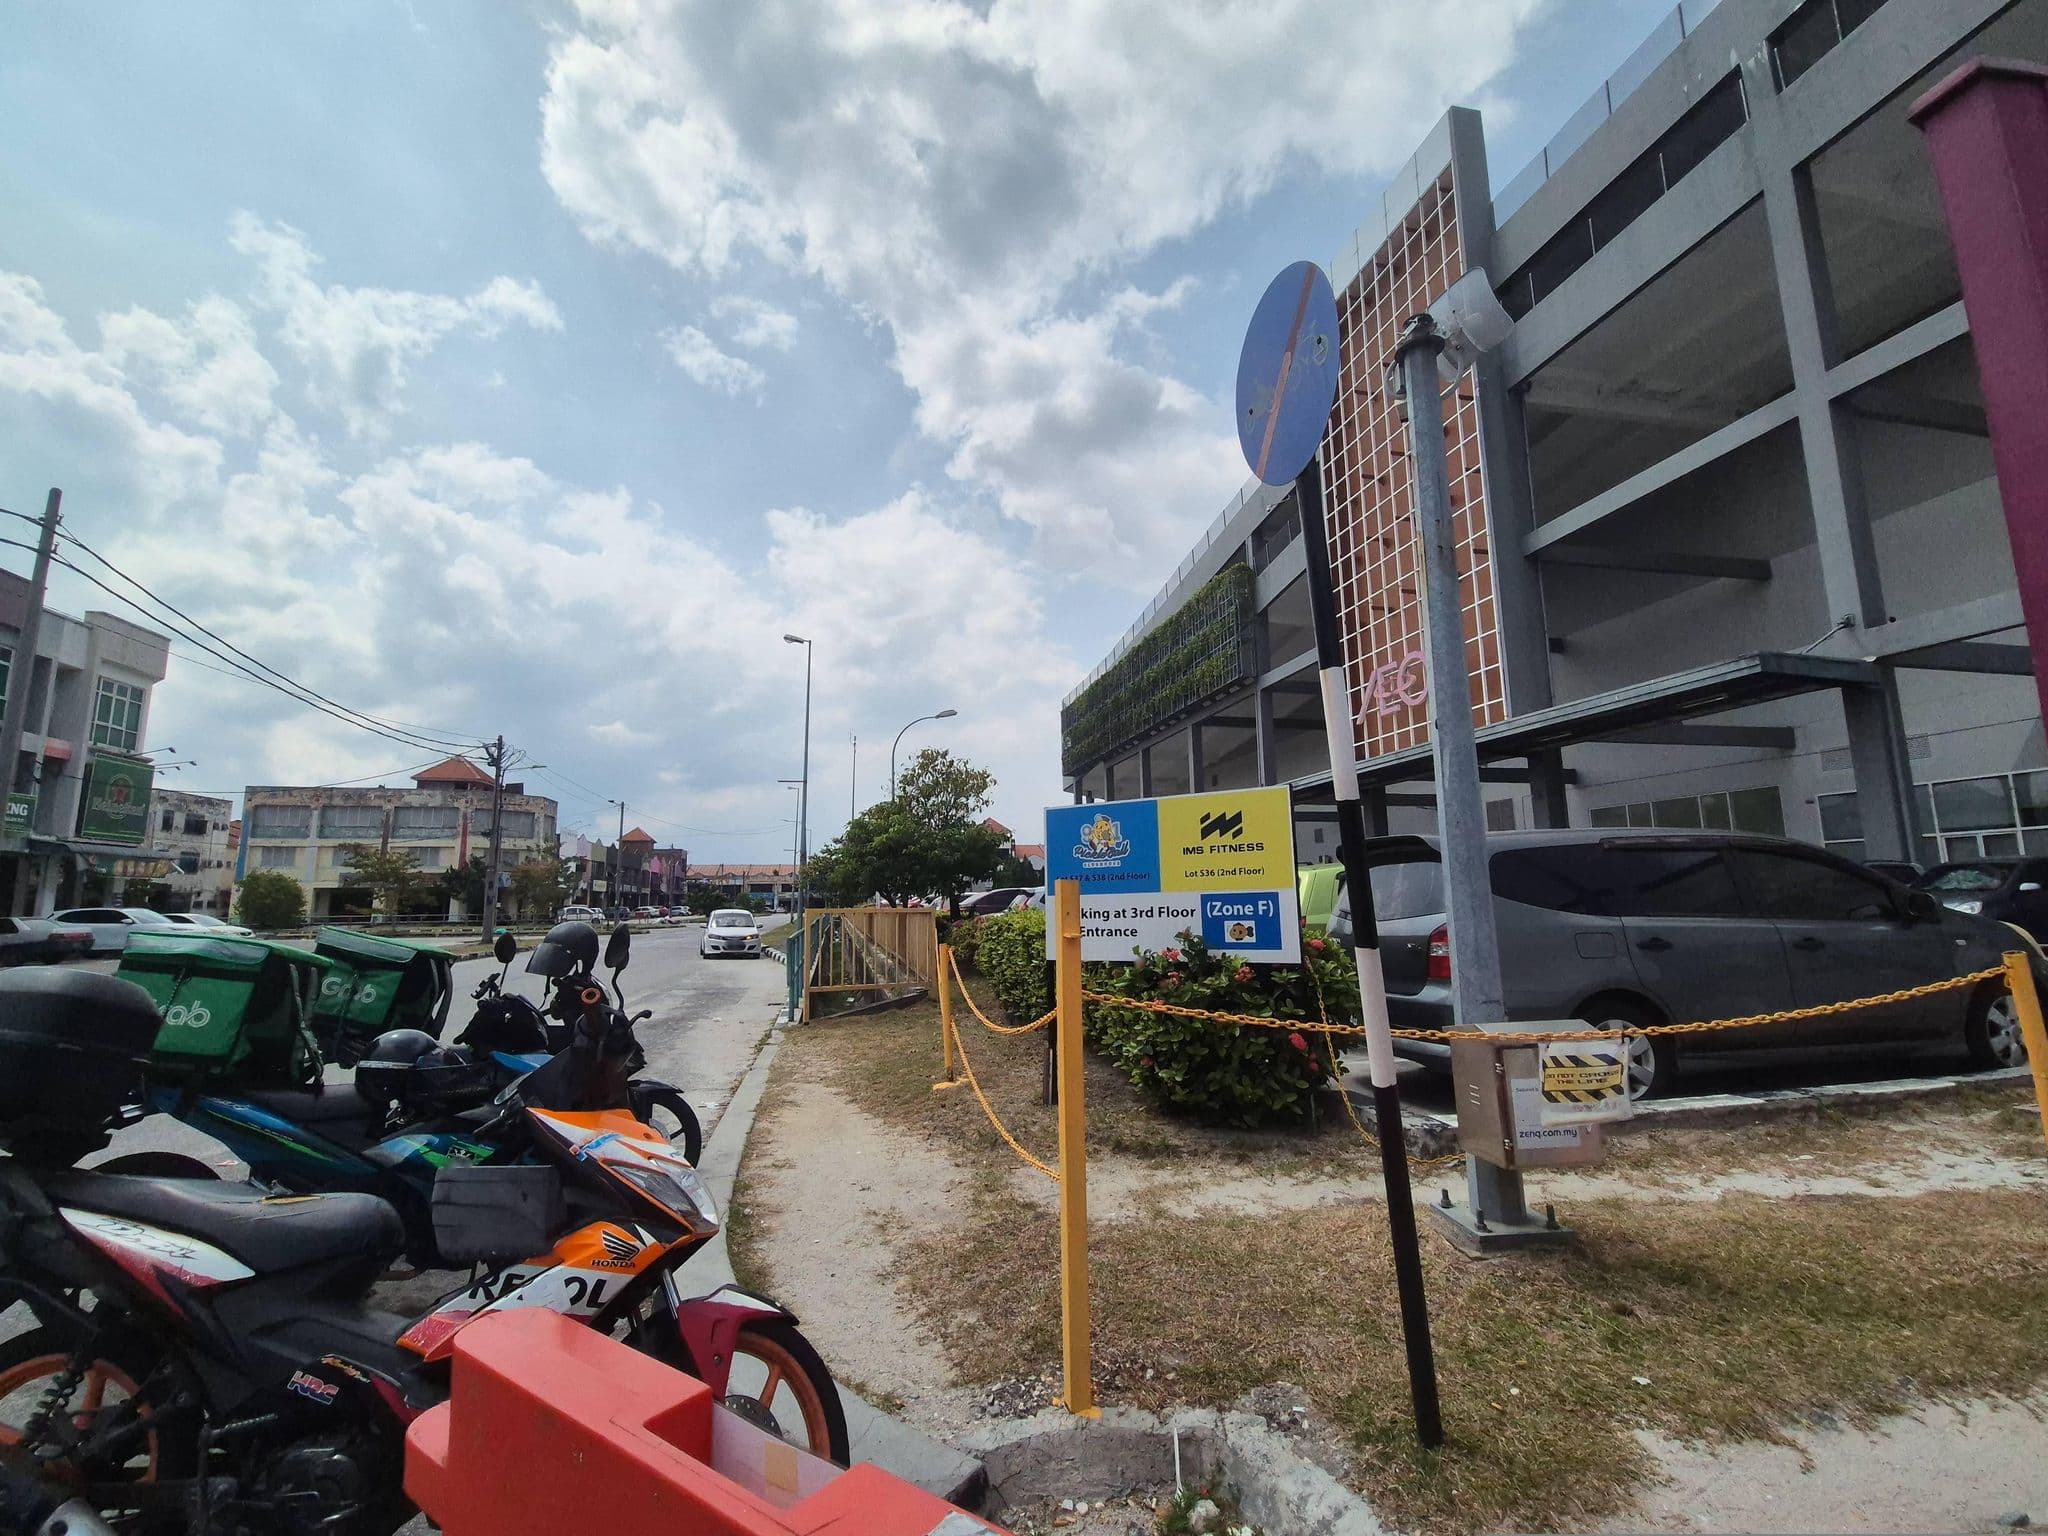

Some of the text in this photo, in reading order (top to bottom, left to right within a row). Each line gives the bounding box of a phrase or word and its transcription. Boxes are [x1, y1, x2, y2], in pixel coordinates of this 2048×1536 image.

[1183, 843, 1264, 855] IMS FITNESS
[1092, 873, 1106, 881] S38
[1108, 872, 1125, 882] (2nd
[1126, 872, 1150, 880] Floor)
[1185, 866, 1265, 878] Lot S36 (2nd Floor)
[1081, 906, 1196, 921] king at 3rd Floor
[1206, 900, 1274, 918] (Zone F)
[1080, 926, 1138, 937] Entrance
[1519, 1128, 1577, 1140] zenq.com.my
[591, 1259, 636, 1269] HONDA
[469, 1273, 608, 1309] REOL
[287, 1370, 339, 1405] HRC
